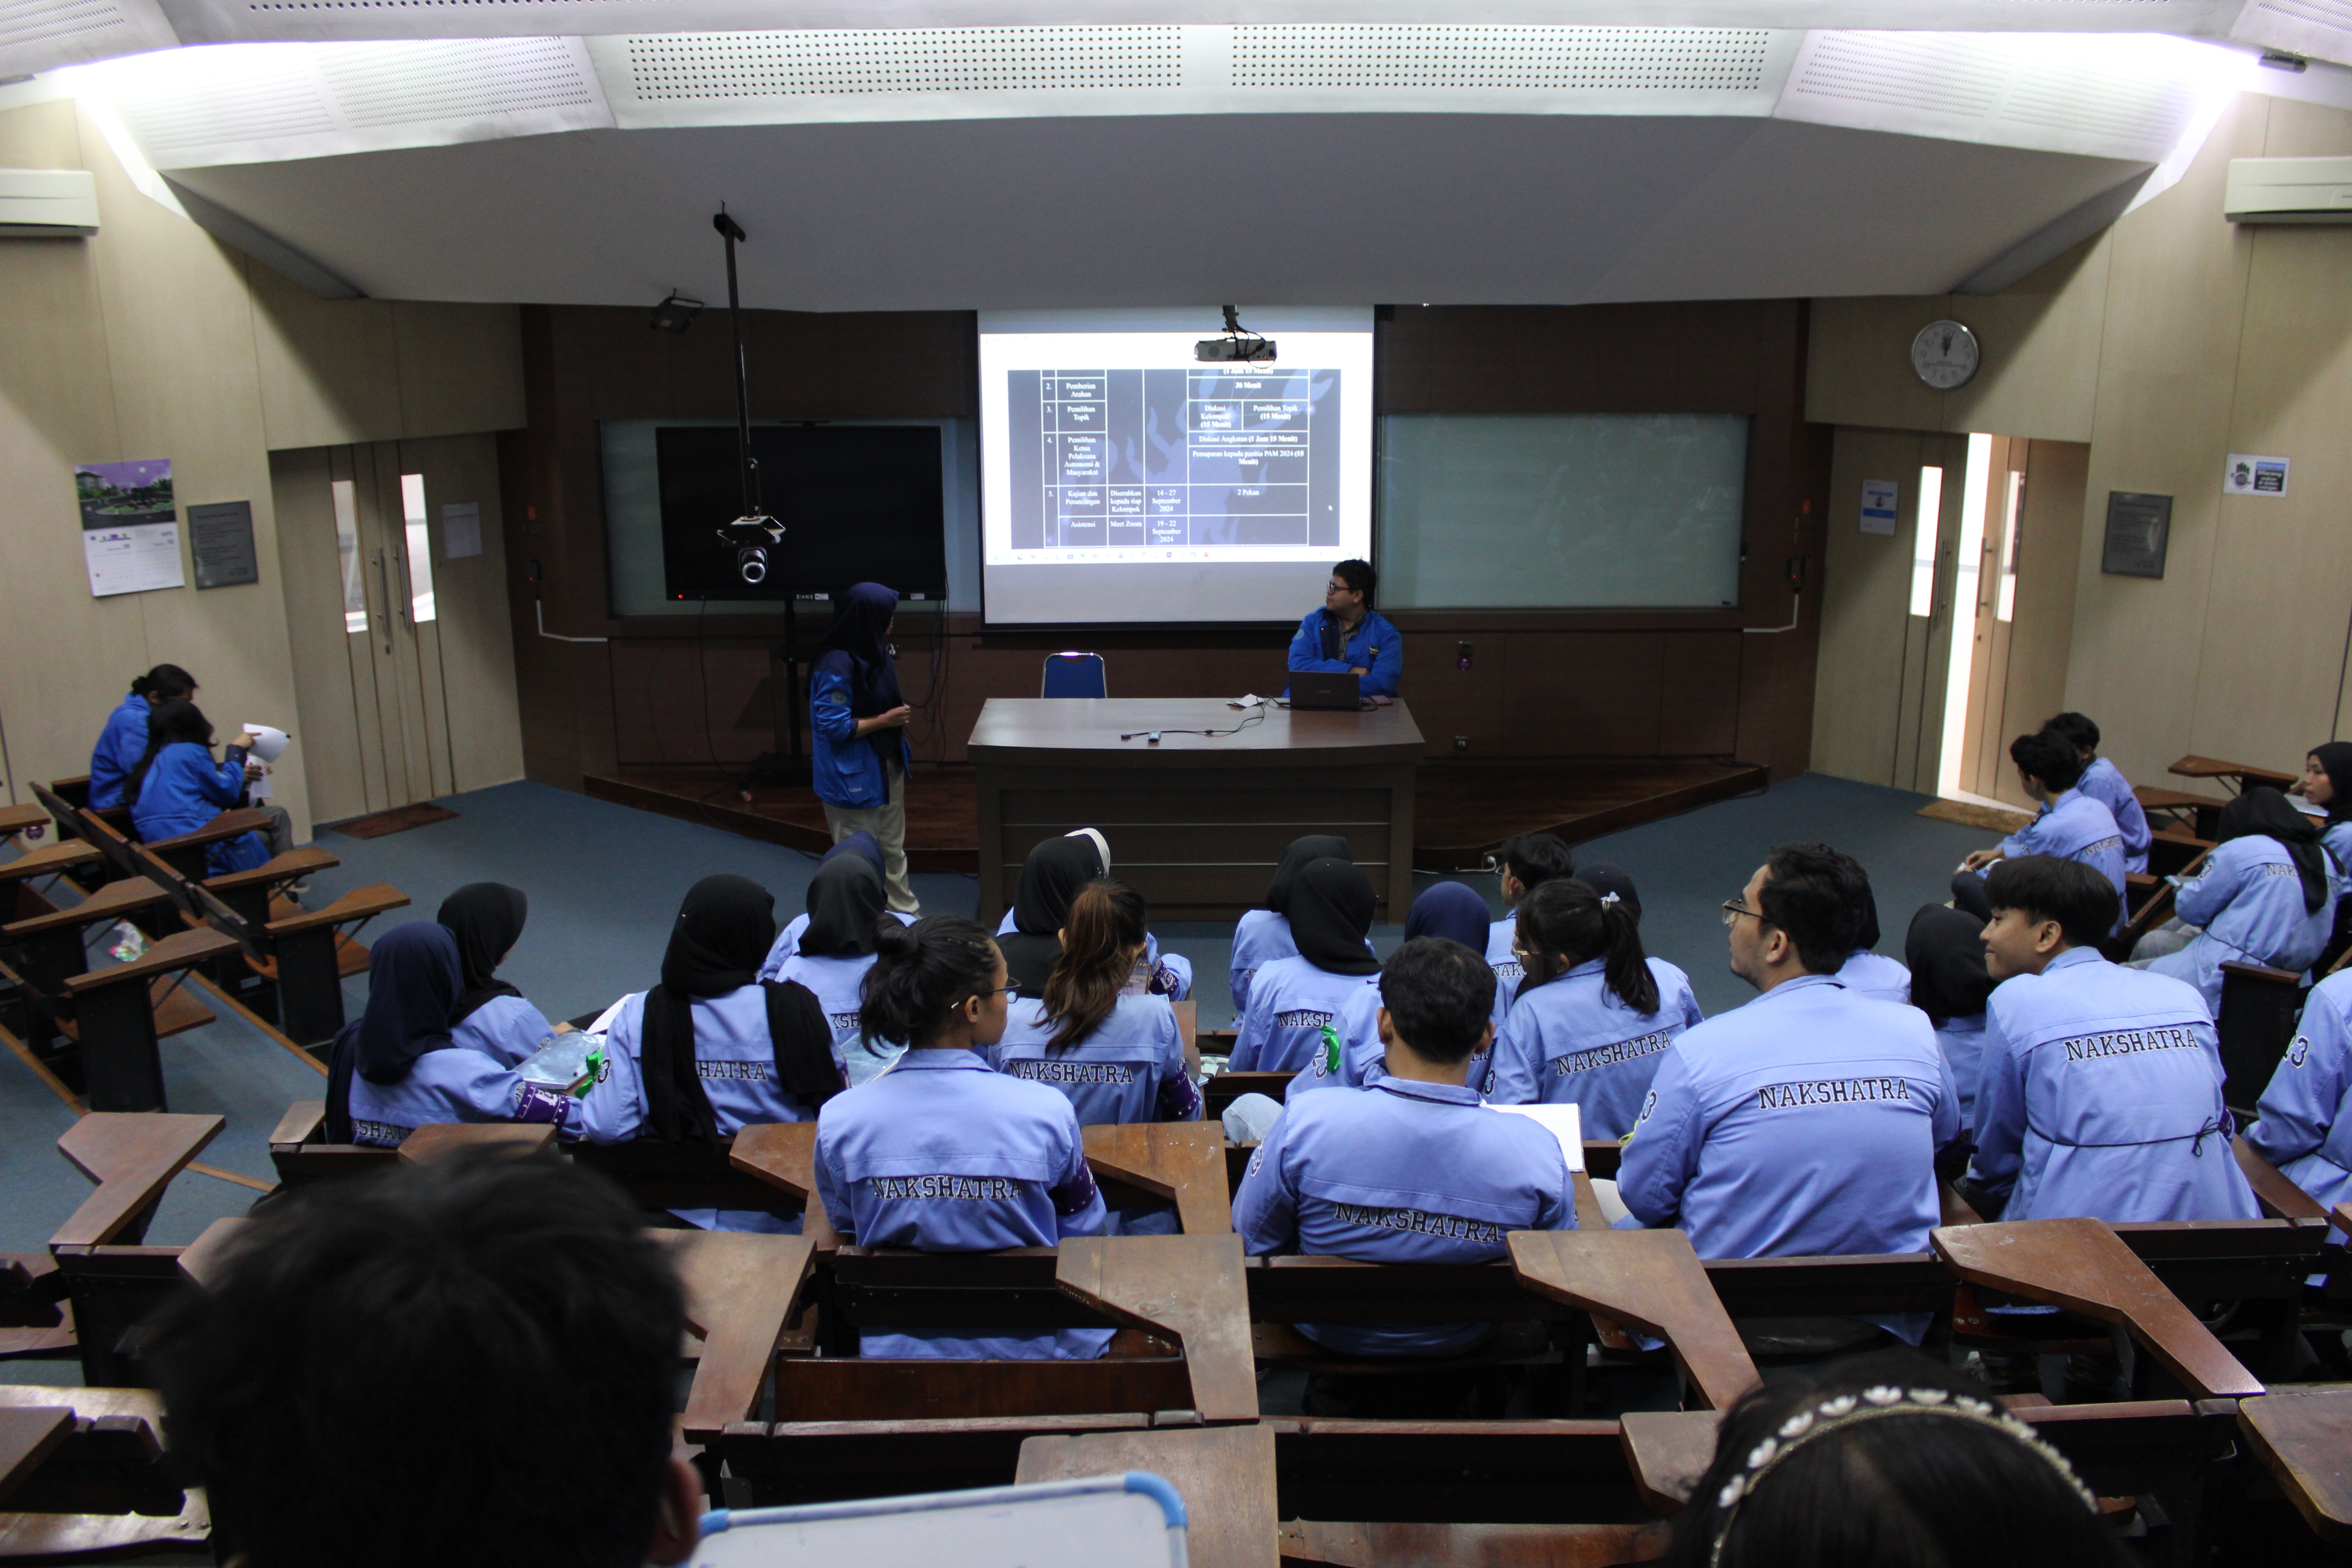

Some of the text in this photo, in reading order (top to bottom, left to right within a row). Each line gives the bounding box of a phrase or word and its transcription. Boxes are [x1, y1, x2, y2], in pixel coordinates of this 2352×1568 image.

[1073, 414, 1090, 422] Topik
[1201, 413, 1230, 421] Kelompok
[1068, 490, 1086, 498] Kajian
[2265, 864, 2298, 877] NAK
[1490, 963, 1527, 978] NAK
[1555, 1030, 1671, 1076] NAKSHATRA
[2063, 1028, 2199, 1062] NAKSHATRA
[1008, 1061, 1134, 1084] NAKSHATRA
[1757, 1077, 1910, 1111] NAKSHATRA
[871, 1175, 1022, 1201] NAKSHATRA
[1334, 1202, 1501, 1244] NAKSHATRA
